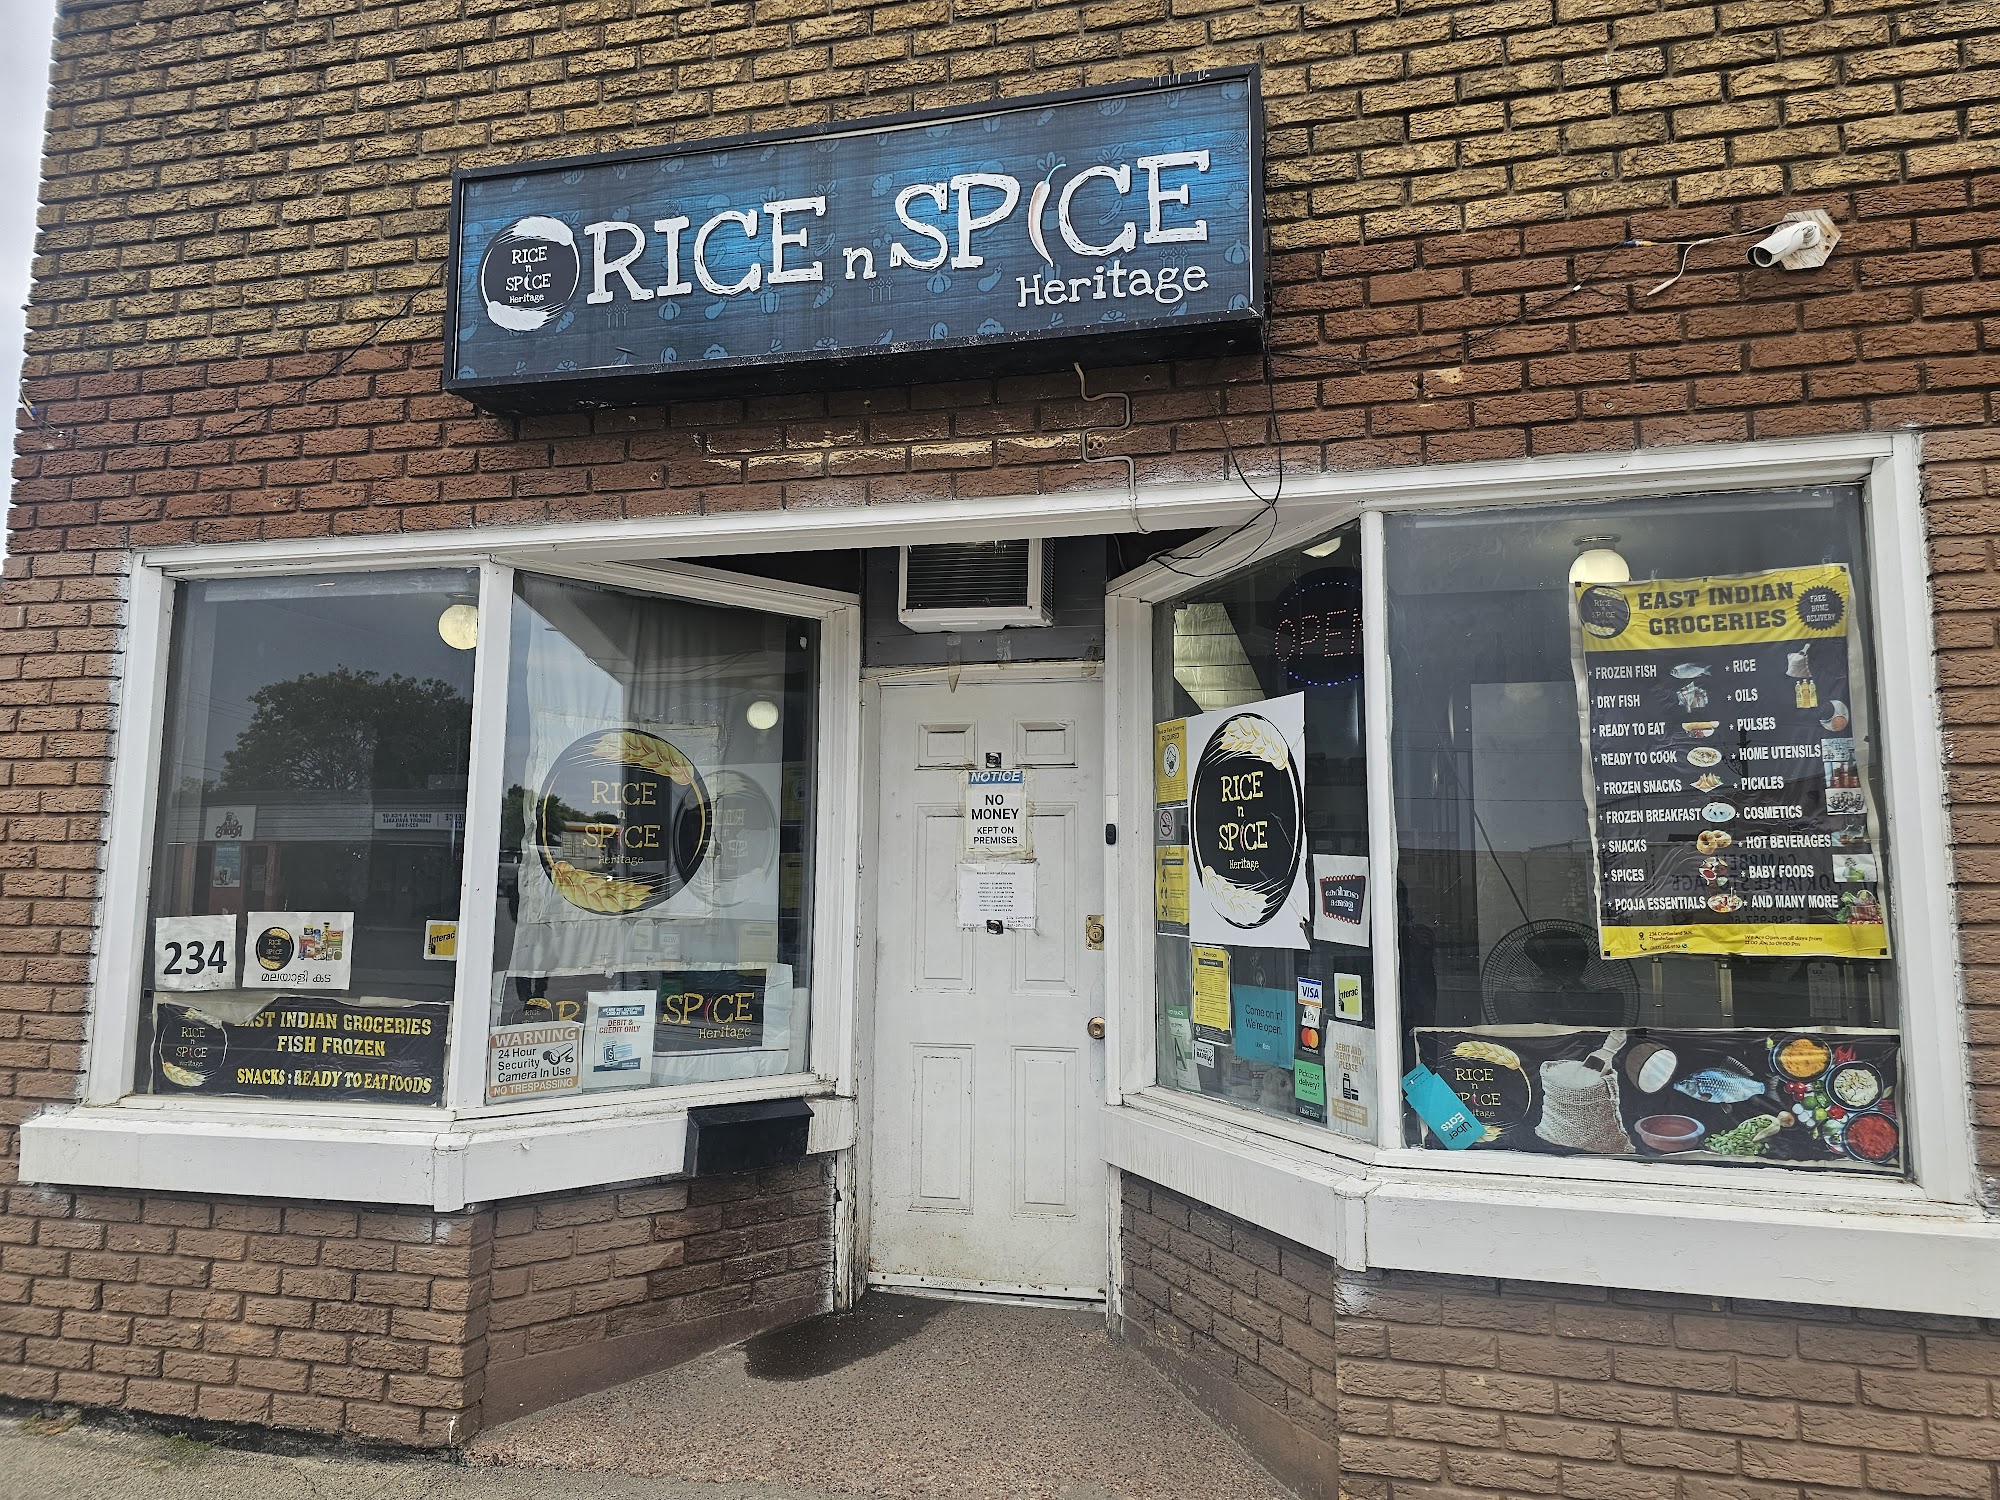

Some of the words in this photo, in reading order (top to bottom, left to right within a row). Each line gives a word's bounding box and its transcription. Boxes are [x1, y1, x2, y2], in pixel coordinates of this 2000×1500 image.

[584, 196, 827, 305] RICE
[843, 246, 877, 281] n
[890, 150, 1210, 268] SPICE
[511, 246, 548, 265] RICE
[525, 264, 532, 273] n
[505, 273, 552, 291] SPICE
[1018, 261, 1208, 308] Heritage
[509, 293, 545, 304] Heritage
[1637, 589, 1700, 610] EAST
[1708, 582, 1795, 605] INDIAN
[1809, 594, 1827, 603] FREE
[1811, 603, 1829, 613] HOME
[1649, 609, 1787, 636] GROCERIES
[1806, 613, 1836, 623] DELIVERY
[1595, 665, 1633, 680] FROZEN
[1635, 664, 1657, 679] FISH
[1732, 659, 1757, 673] RICE
[1597, 695, 1617, 709] DRY
[1618, 694, 1641, 708] FISH
[1735, 688, 1758, 703] OILS
[1598, 723, 1631, 738] READY
[1632, 722, 1645, 736] TO
[1647, 721, 1666, 736] EAT
[1737, 717, 1776, 732] PULSES
[1601, 752, 1632, 767] READY
[1634, 751, 1648, 765] TO
[1649, 750, 1677, 764] COOK
[1739, 746, 1769, 761] HOME
[1770, 744, 1821, 760] UTENSILS
[970, 771, 1022, 783] NOTICE
[1741, 775, 1784, 791] PICKLES
[590, 780, 658, 806] RICE
[1220, 771, 1264, 802] RICE
[1603, 780, 1641, 795] FROZEN
[1642, 779, 1682, 794] SNACKS
[985, 794, 1004, 806] NO
[616, 808, 626, 819] n
[971, 808, 1020, 820] MONEY
[1237, 805, 1244, 817] n
[1606, 809, 1644, 824] FROZEN
[1645, 807, 1701, 823] BREAKFAST
[1743, 805, 1803, 820] COSMETICS
[582, 824, 661, 849] SPICE
[976, 826, 998, 835] KEPT
[1000, 826, 1014, 834] ON
[1218, 820, 1268, 852] SPICE
[973, 836, 1018, 844] PREMISES
[1608, 839, 1647, 854] SNACKS
[1746, 836, 1768, 850] HOT
[1769, 834, 1832, 849] BEVERAGES
[598, 854, 645, 867] Heritage
[1229, 858, 1260, 871] Heritage
[1610, 868, 1645, 883] SPICES
[1748, 865, 1778, 880] BABY
[1779, 864, 1814, 879] FOODS
[1614, 897, 1645, 912] POOJA
[1646, 895, 1707, 911] ESSENTIALS
[1751, 894, 1774, 909] AND
[1775, 894, 1805, 910] MANY
[1806, 894, 1839, 909] MORE
[428, 931, 456, 946] Interac
[163, 940, 228, 975] 234
[1301, 985, 1320, 999] VISA
[1338, 985, 1359, 1000] Interac
[662, 992, 756, 1025] SPICE
[1245, 1004, 1265, 1018] Come
[1265, 1009, 1273, 1020] on
[1274, 1010, 1283, 1021] in!
[280, 1011, 338, 1030] INDIAN
[343, 1014, 432, 1036] GROCERIES
[607, 1019, 627, 1027] DEBIT
[1307, 1011, 1317, 1023] Pay
[180, 1027, 206, 1038] RICE
[599, 1026, 623, 1034] CREDIT
[624, 1025, 641, 1033] ONLY
[698, 1026, 752, 1040] Heritage
[1245, 1017, 1263, 1031] We're
[1264, 1023, 1283, 1036] open.
[495, 1027, 577, 1048] WARNING
[175, 1046, 208, 1059] SPICE
[276, 1035, 316, 1053] FISH
[321, 1036, 386, 1057] FROZEN
[498, 1049, 511, 1060] 24
[512, 1047, 537, 1059] Hour
[1335, 1042, 1350, 1053] DEBIT
[1333, 1050, 1350, 1062] CREDIT
[498, 1059, 540, 1073] Security
[1338, 1061, 1359, 1073] PLEASE
[236, 1067, 286, 1086] SNACKS
[294, 1069, 342, 1088] READY
[344, 1071, 362, 1088] TO
[363, 1072, 388, 1091] EAT
[388, 1073, 433, 1094] FOODS
[498, 1070, 539, 1083] Camera
[540, 1068, 549, 1079] In
[552, 1066, 571, 1078] Use
[1298, 1068, 1315, 1080] Pickup
[1454, 1067, 1494, 1081] RICE
[494, 1085, 508, 1095] NO
[509, 1077, 573, 1094] TRESPASSING
[1298, 1077, 1320, 1090] delivery?
[1456, 1091, 1502, 1106] PICE
[1299, 1107, 1310, 1116] Uber
[1440, 1112, 1466, 1132] Eats
[1449, 1121, 1473, 1141] Uber
